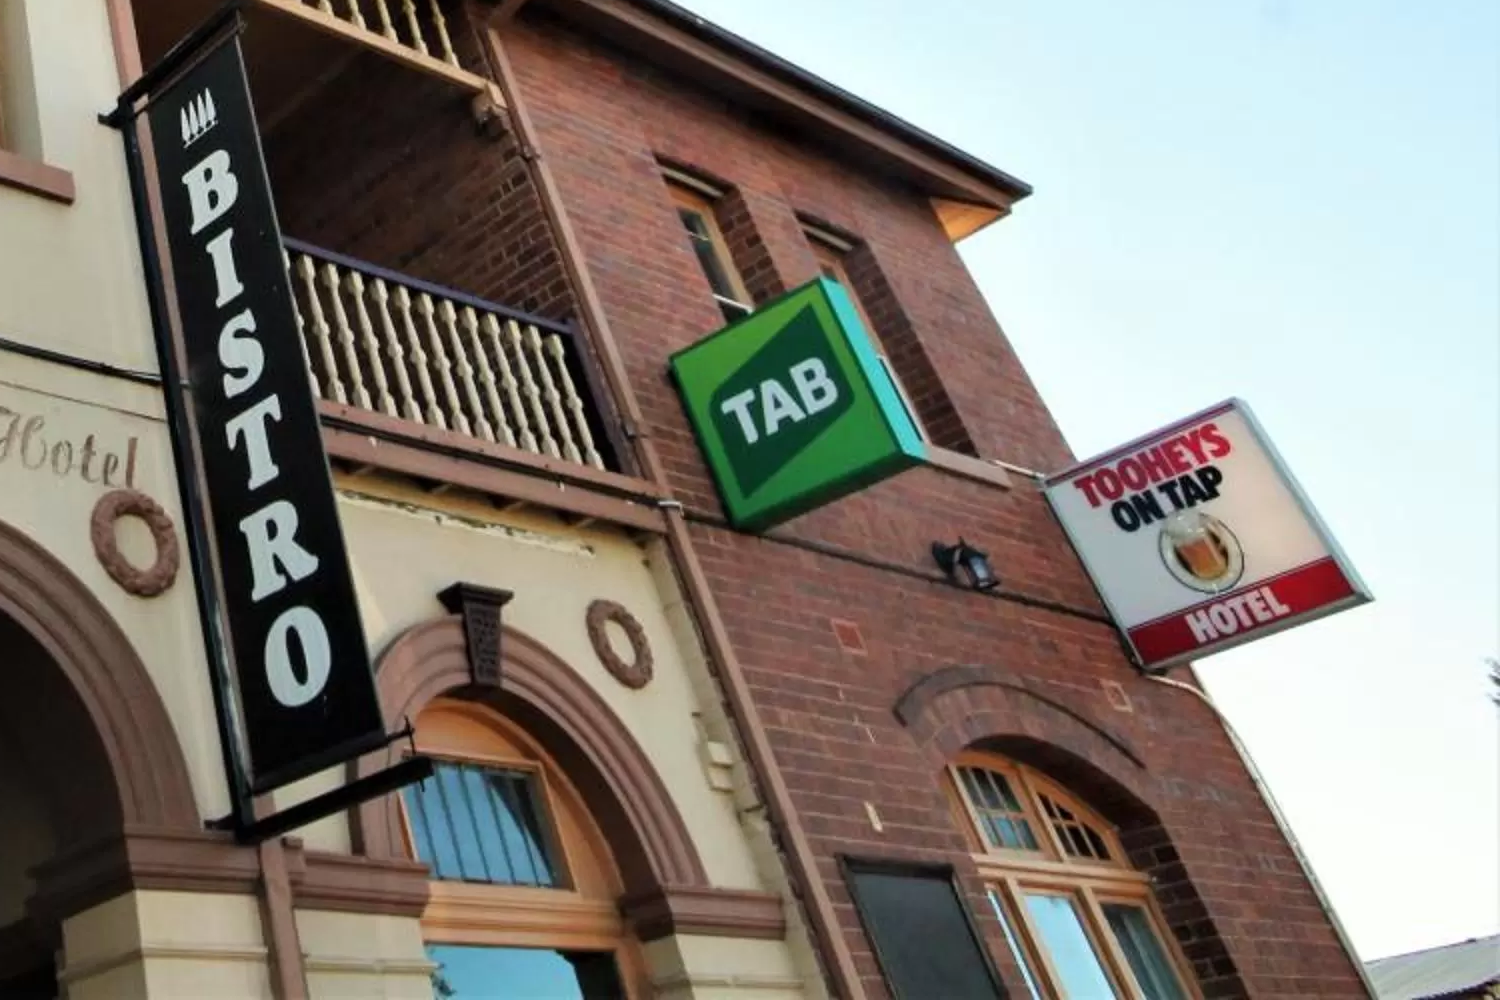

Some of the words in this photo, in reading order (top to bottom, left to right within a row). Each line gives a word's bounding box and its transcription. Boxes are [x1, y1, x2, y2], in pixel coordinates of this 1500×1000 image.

[181, 148, 332, 708] BISTRO
[721, 356, 839, 445] TAB
[1073, 423, 1232, 508] TOOHEYS
[1110, 487, 1167, 532] ON
[1157, 465, 1223, 511] TAP
[1184, 587, 1291, 643] HOTEL
